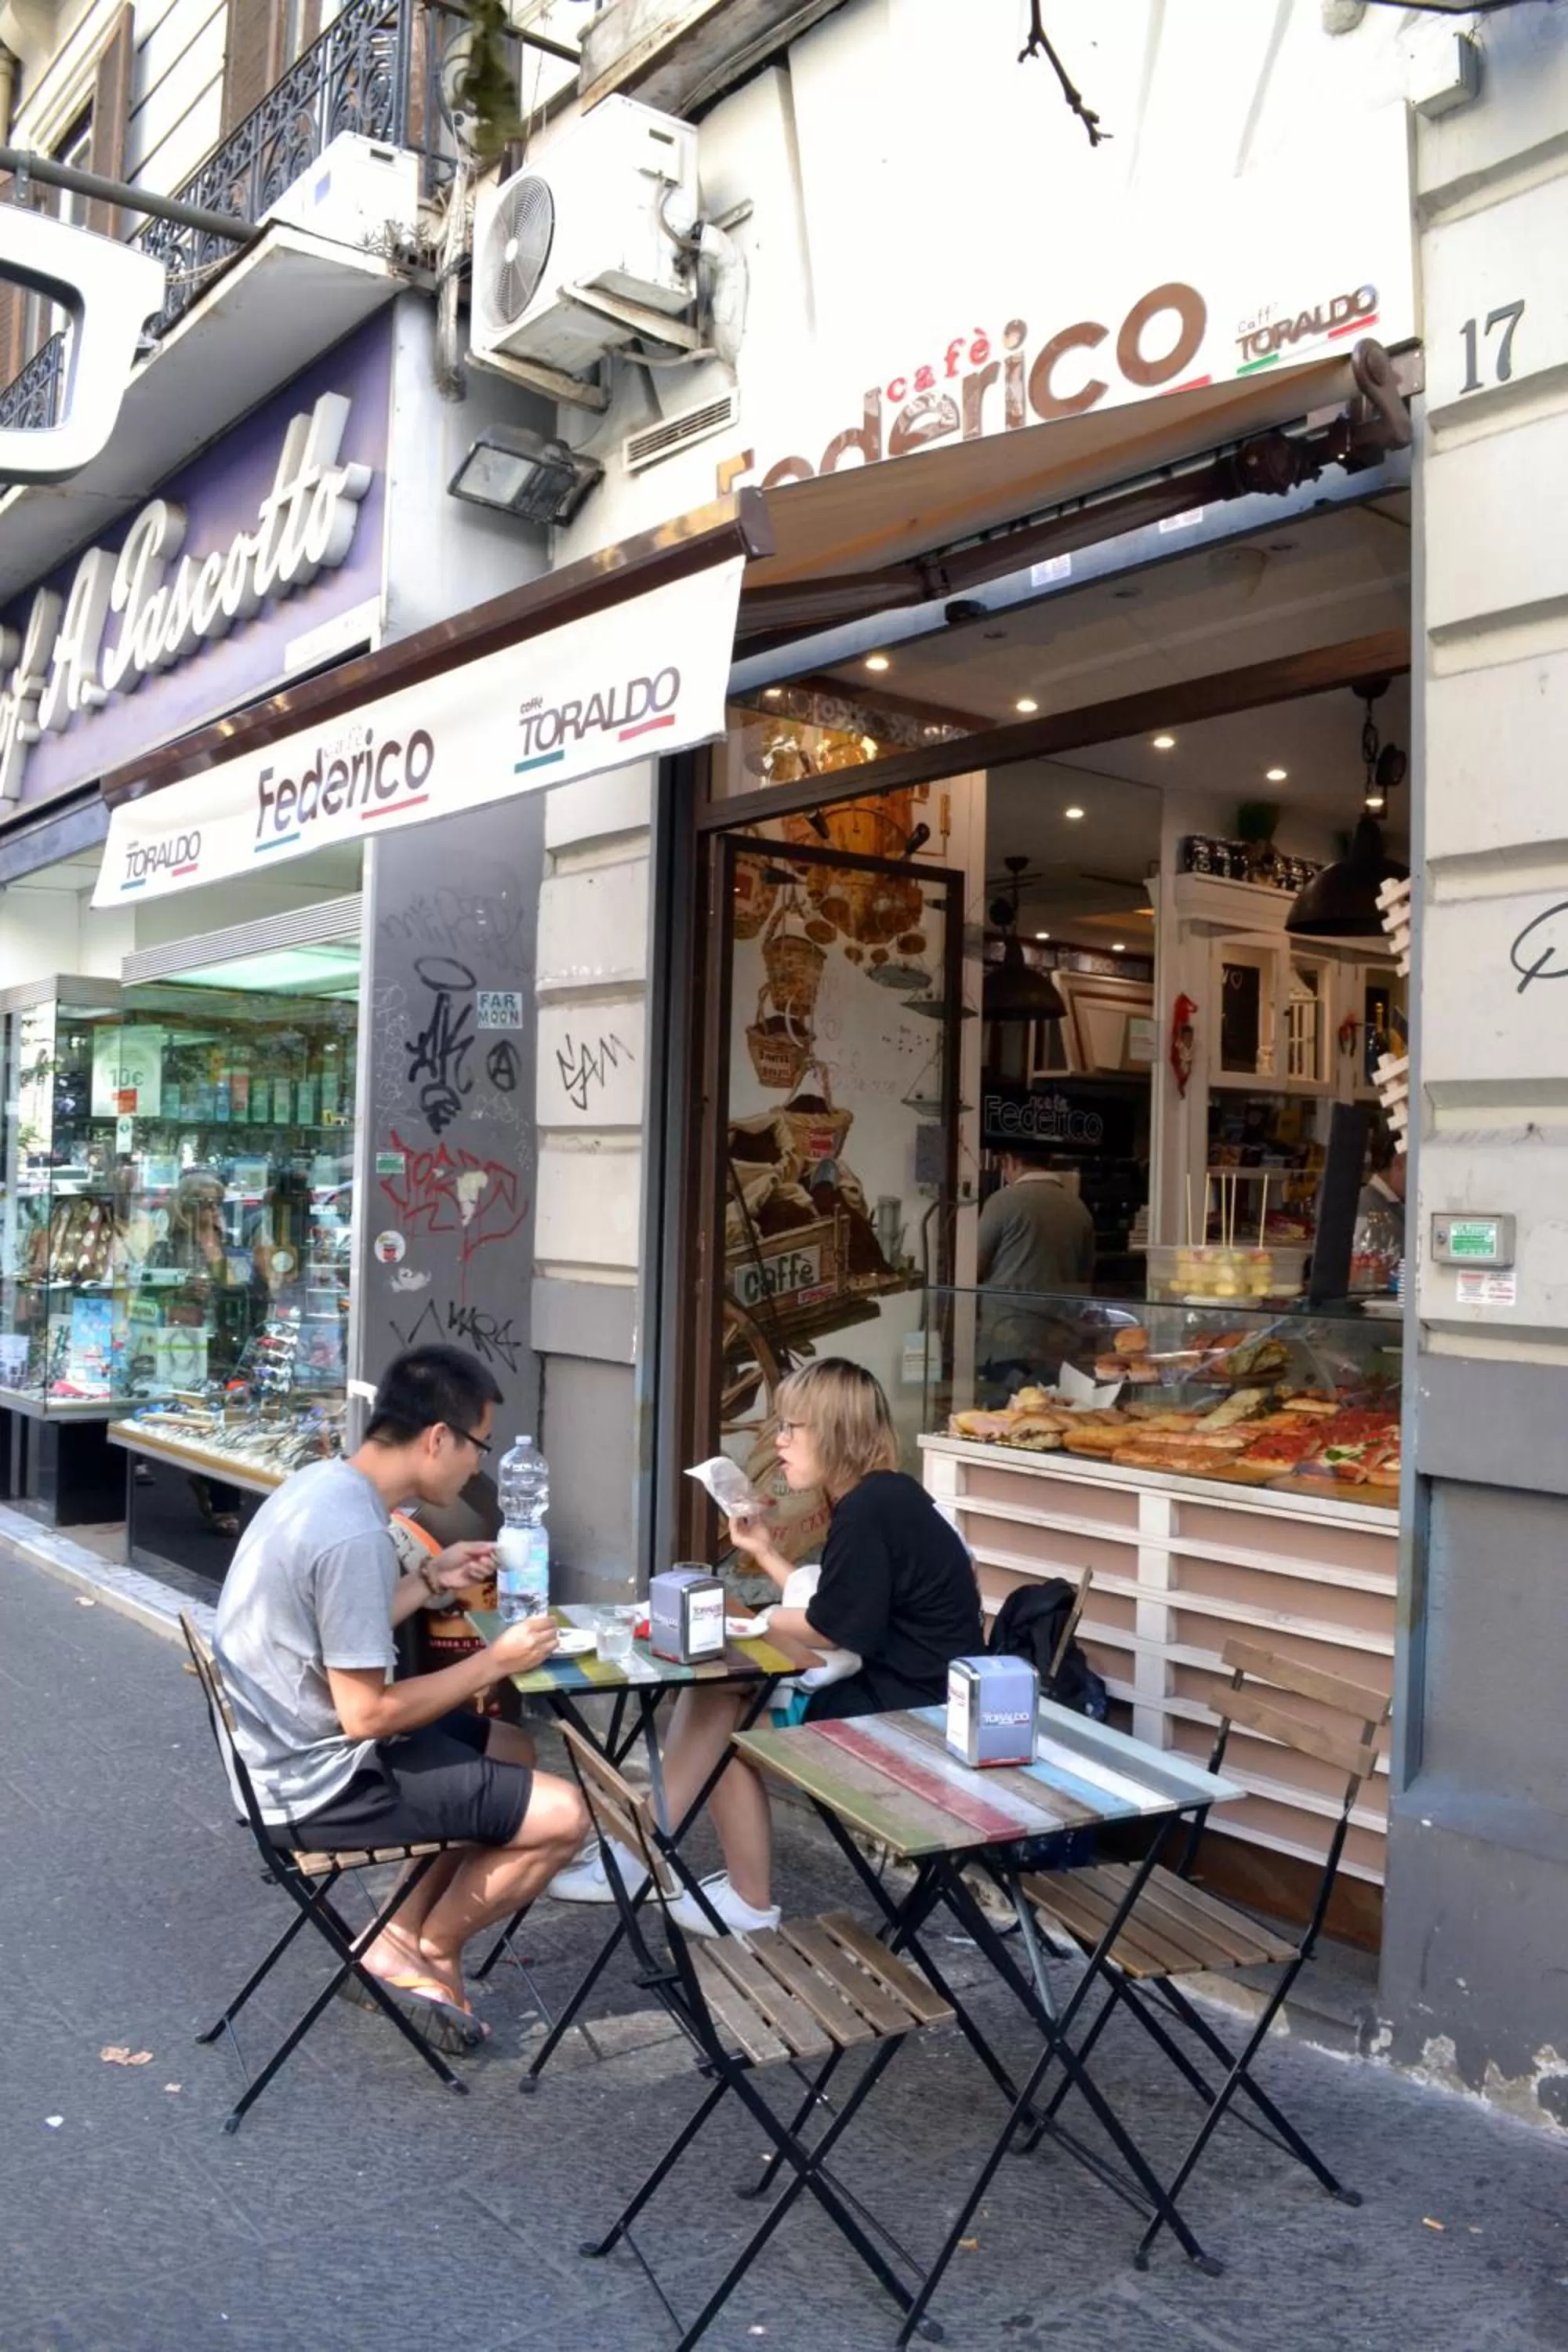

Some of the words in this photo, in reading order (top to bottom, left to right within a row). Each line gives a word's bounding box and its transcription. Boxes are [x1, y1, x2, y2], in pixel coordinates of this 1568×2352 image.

[1236, 284, 1378, 361] TORALDO
[1459, 299, 1525, 394] 17
[887, 328, 991, 403] cafè
[519, 666, 681, 756] TORALDO
[256, 728, 434, 838] Federico
[125, 830, 201, 878] TORALDO
[480, 993, 515, 1009] FAR
[109, 1068, 145, 1087] 10€
